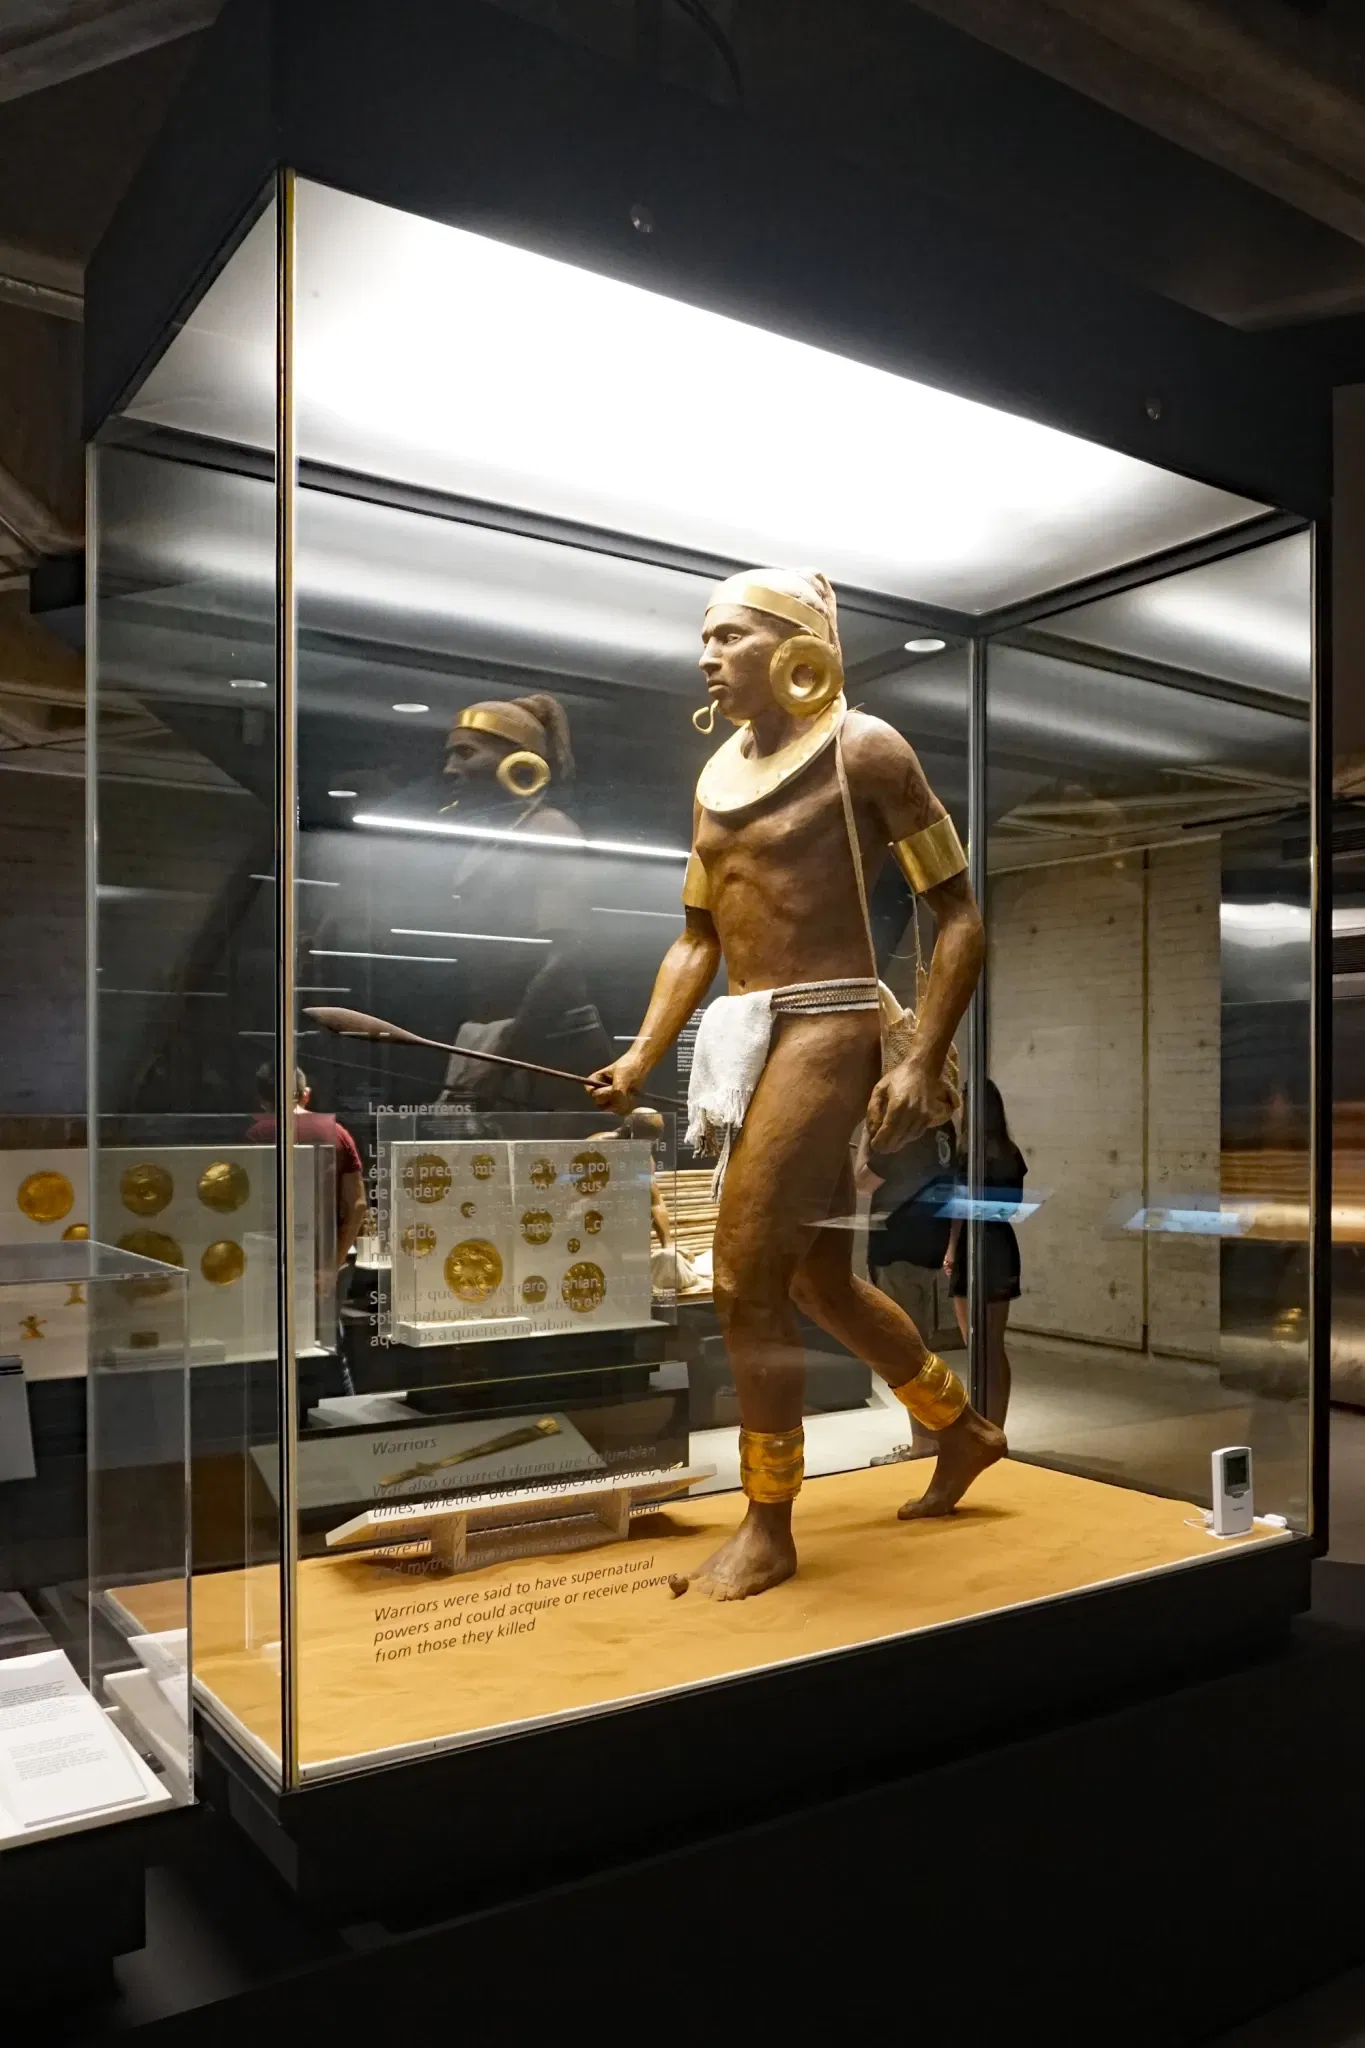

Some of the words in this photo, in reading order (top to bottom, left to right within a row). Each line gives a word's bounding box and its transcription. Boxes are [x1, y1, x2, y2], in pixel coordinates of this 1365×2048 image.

[368, 1101, 394, 1116] Los
[399, 1104, 472, 1119] guerreros
[369, 1144, 385, 1158] La
[656, 1139, 667, 1152] la
[369, 1164, 414, 1181] épca
[588, 1161, 611, 1177] por
[369, 1185, 388, 1200] de
[581, 1181, 602, 1192] sus
[370, 1291, 387, 1304] Se
[370, 1329, 434, 1350] aqueos
[439, 1332, 447, 1341] a
[451, 1325, 508, 1343] quienes
[511, 1317, 573, 1335] mataban
[372, 1438, 437, 1455] Warriors
[408, 1478, 438, 1493] also
[442, 1466, 505, 1487] occurred
[373, 1502, 416, 1519] times,
[423, 1491, 486, 1510] whether
[488, 1485, 521, 1500] over
[523, 1474, 586, 1496] struggles
[589, 1470, 608, 1484] for
[612, 1464, 656, 1485] power,
[374, 1600, 439, 1622] Warriors
[443, 1592, 480, 1608] were
[483, 1582, 512, 1601] said
[516, 1582, 530, 1595] to
[535, 1576, 567, 1592] have
[571, 1556, 654, 1585] supernatural
[373, 1622, 430, 1646] powers
[433, 1612, 463, 1631] and
[466, 1604, 506, 1624] could
[509, 1595, 560, 1617] acquire
[564, 1592, 580, 1605] or
[583, 1582, 628, 1602] receive
[631, 1572, 679, 1595] powers
[375, 1645, 412, 1664] from
[417, 1636, 457, 1655] those
[462, 1629, 494, 1646] they
[497, 1616, 536, 1639] killed
